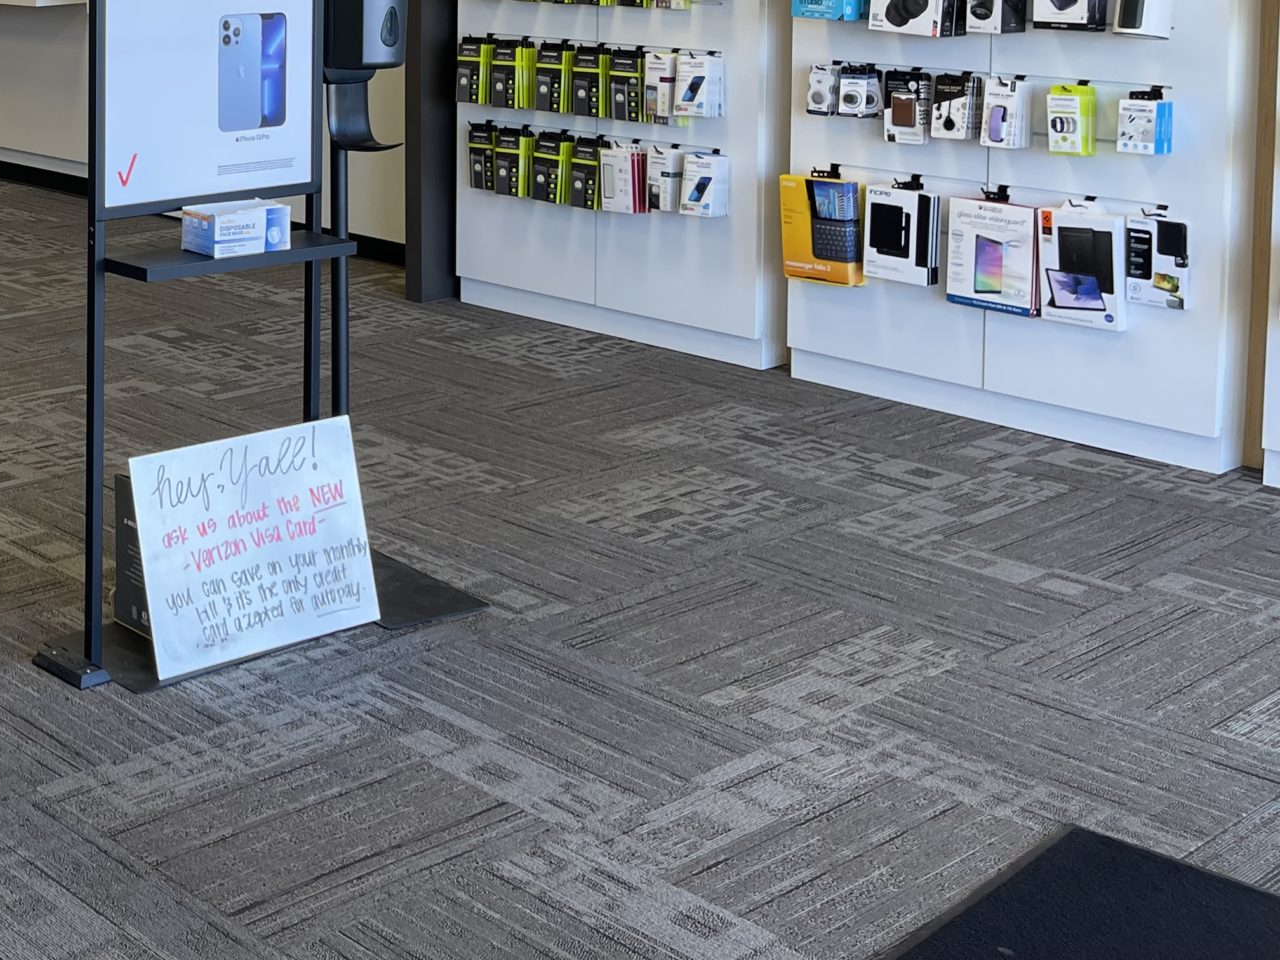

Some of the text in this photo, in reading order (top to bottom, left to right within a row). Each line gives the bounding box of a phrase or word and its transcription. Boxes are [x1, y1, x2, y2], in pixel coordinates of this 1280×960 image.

[220, 222, 255, 232] DISPOSABLE
[151, 464, 224, 512] hey,
[162, 479, 345, 549] ask us about the NEW
[250, 525, 282, 548] Visa
[165, 538, 369, 616] you can save on your monthly
[195, 602, 219, 625] bill
[257, 581, 279, 600] the
[281, 573, 309, 596] only
[313, 564, 348, 588] credit
[202, 618, 230, 643] card
[289, 595, 306, 615] for
